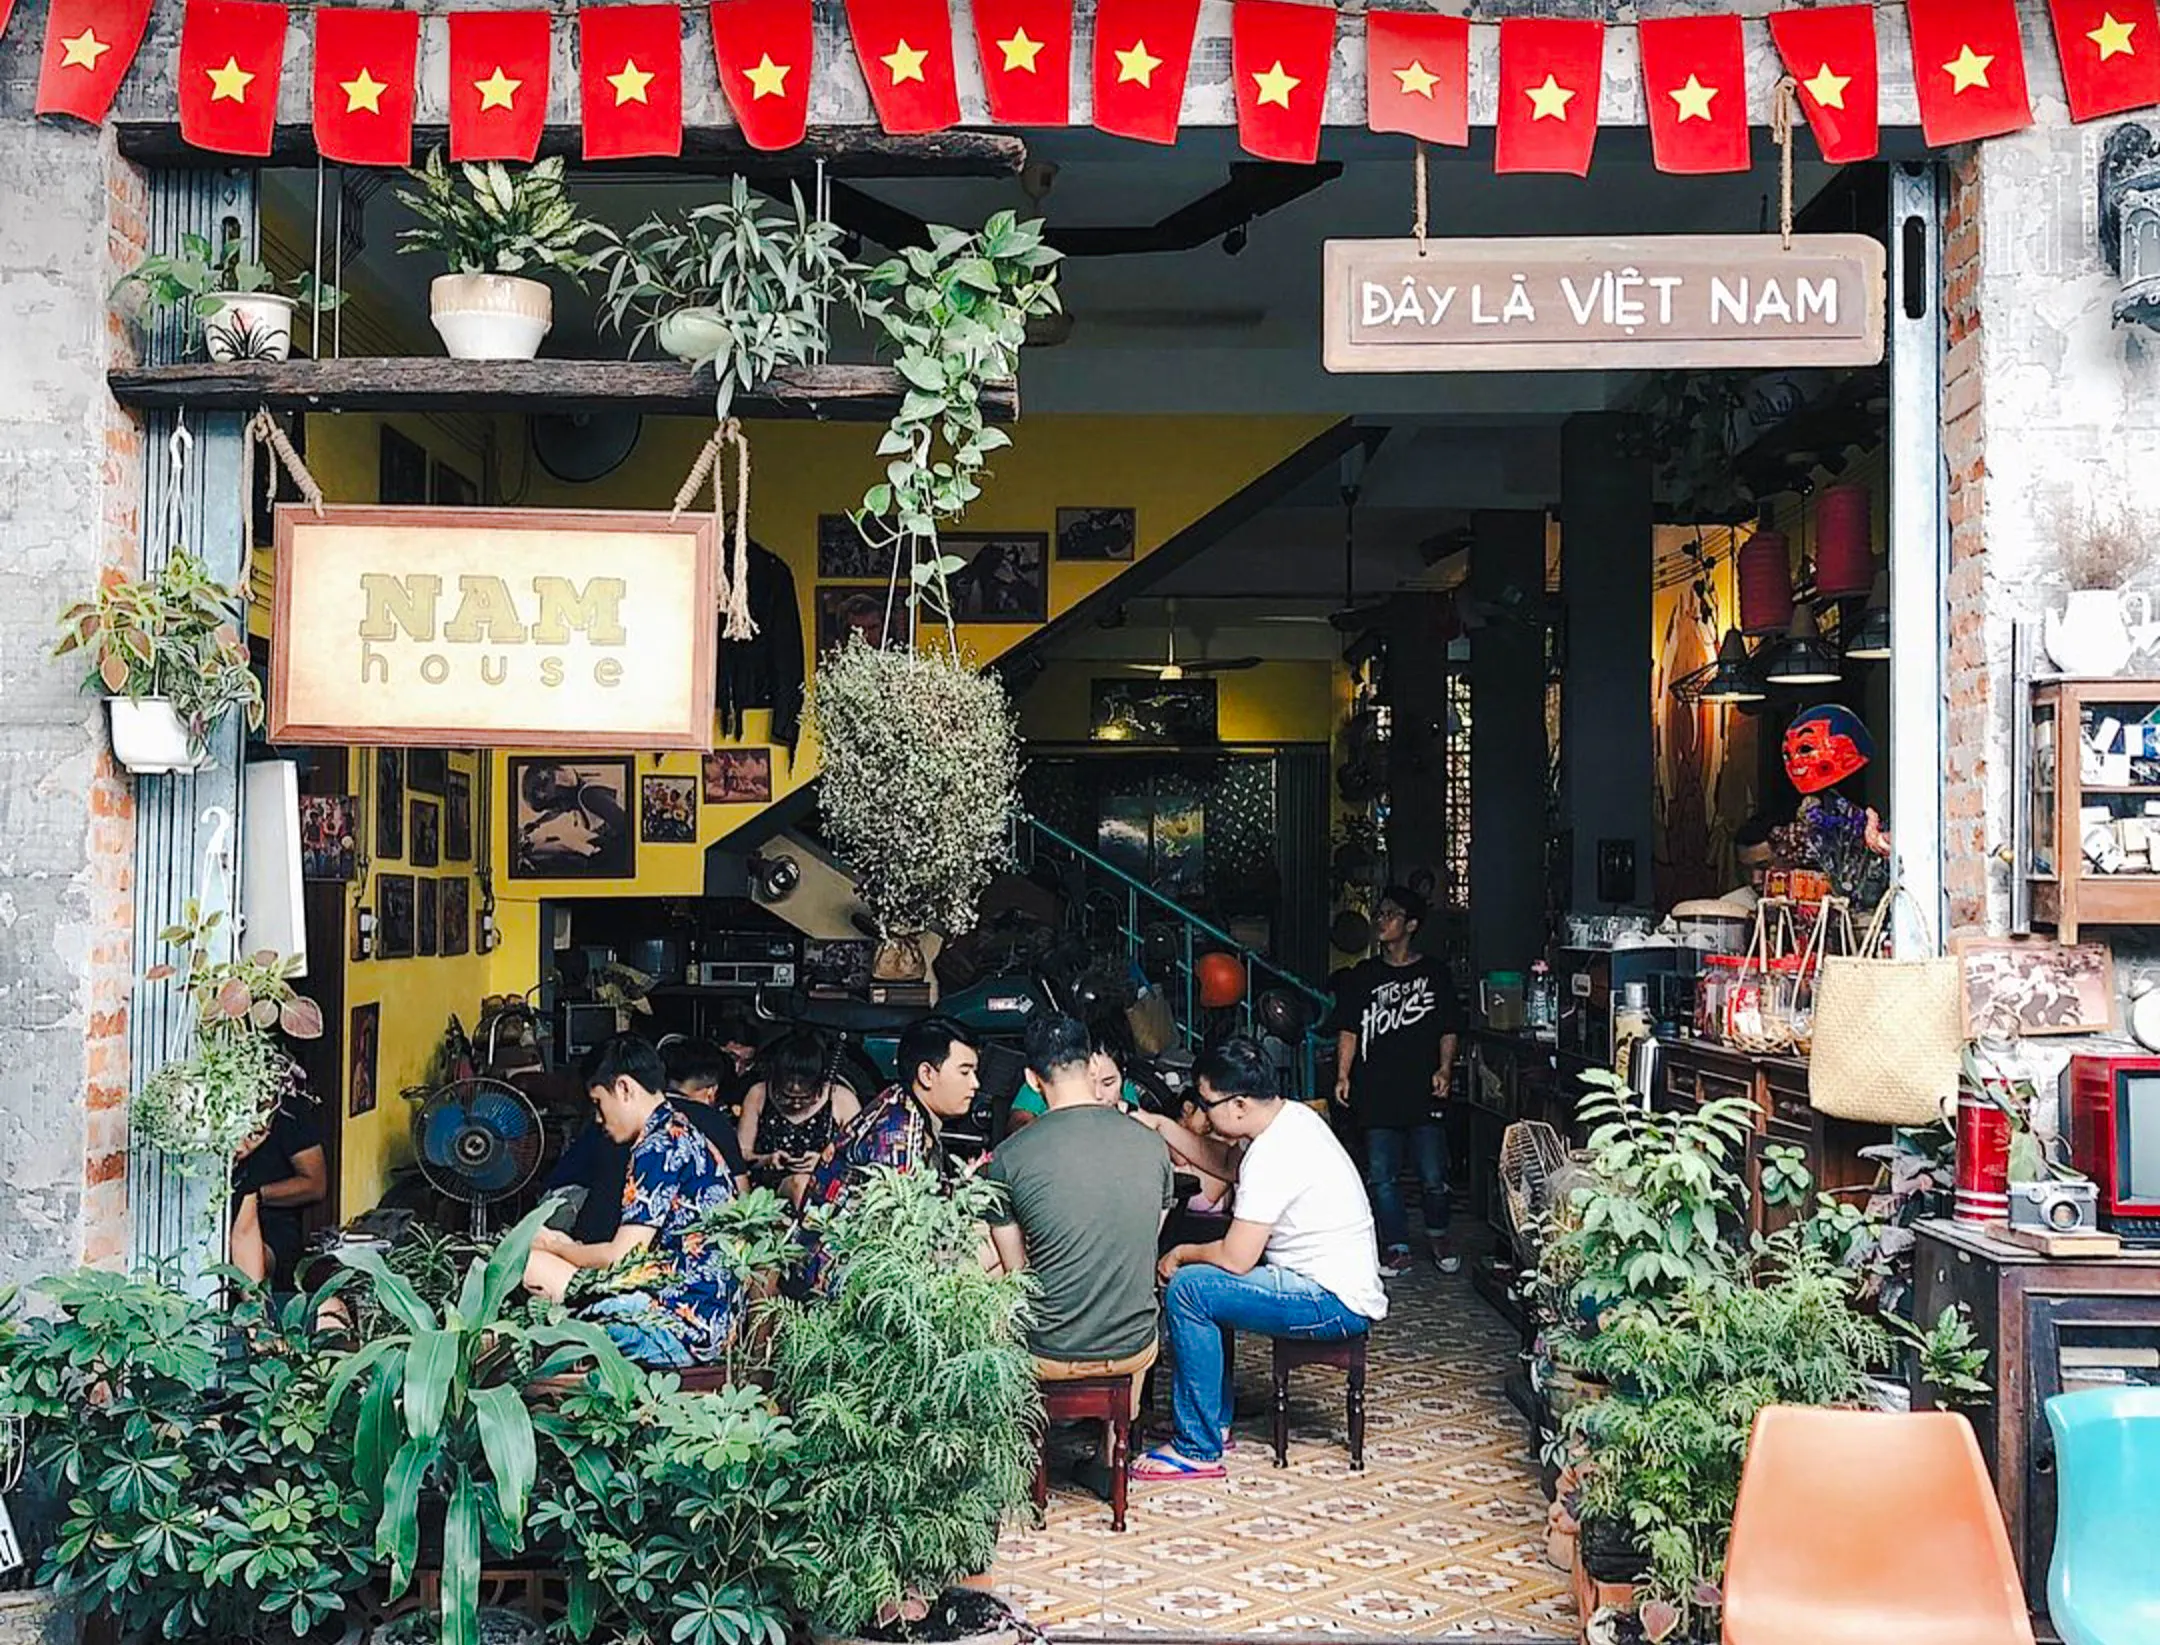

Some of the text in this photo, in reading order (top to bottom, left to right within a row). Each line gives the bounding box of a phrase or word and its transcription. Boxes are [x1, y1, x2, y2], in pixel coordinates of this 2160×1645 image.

[1361, 275, 1457, 325] ĐÂY
[1560, 266, 1683, 334] VIỆT
[1711, 276, 1838, 324] NAM
[359, 573, 627, 646] NAM
[361, 642, 624, 687] house
[1371, 981, 1401, 1005] THIS
[1412, 976, 1429, 995] MY
[1360, 992, 1436, 1062] HOUSE
